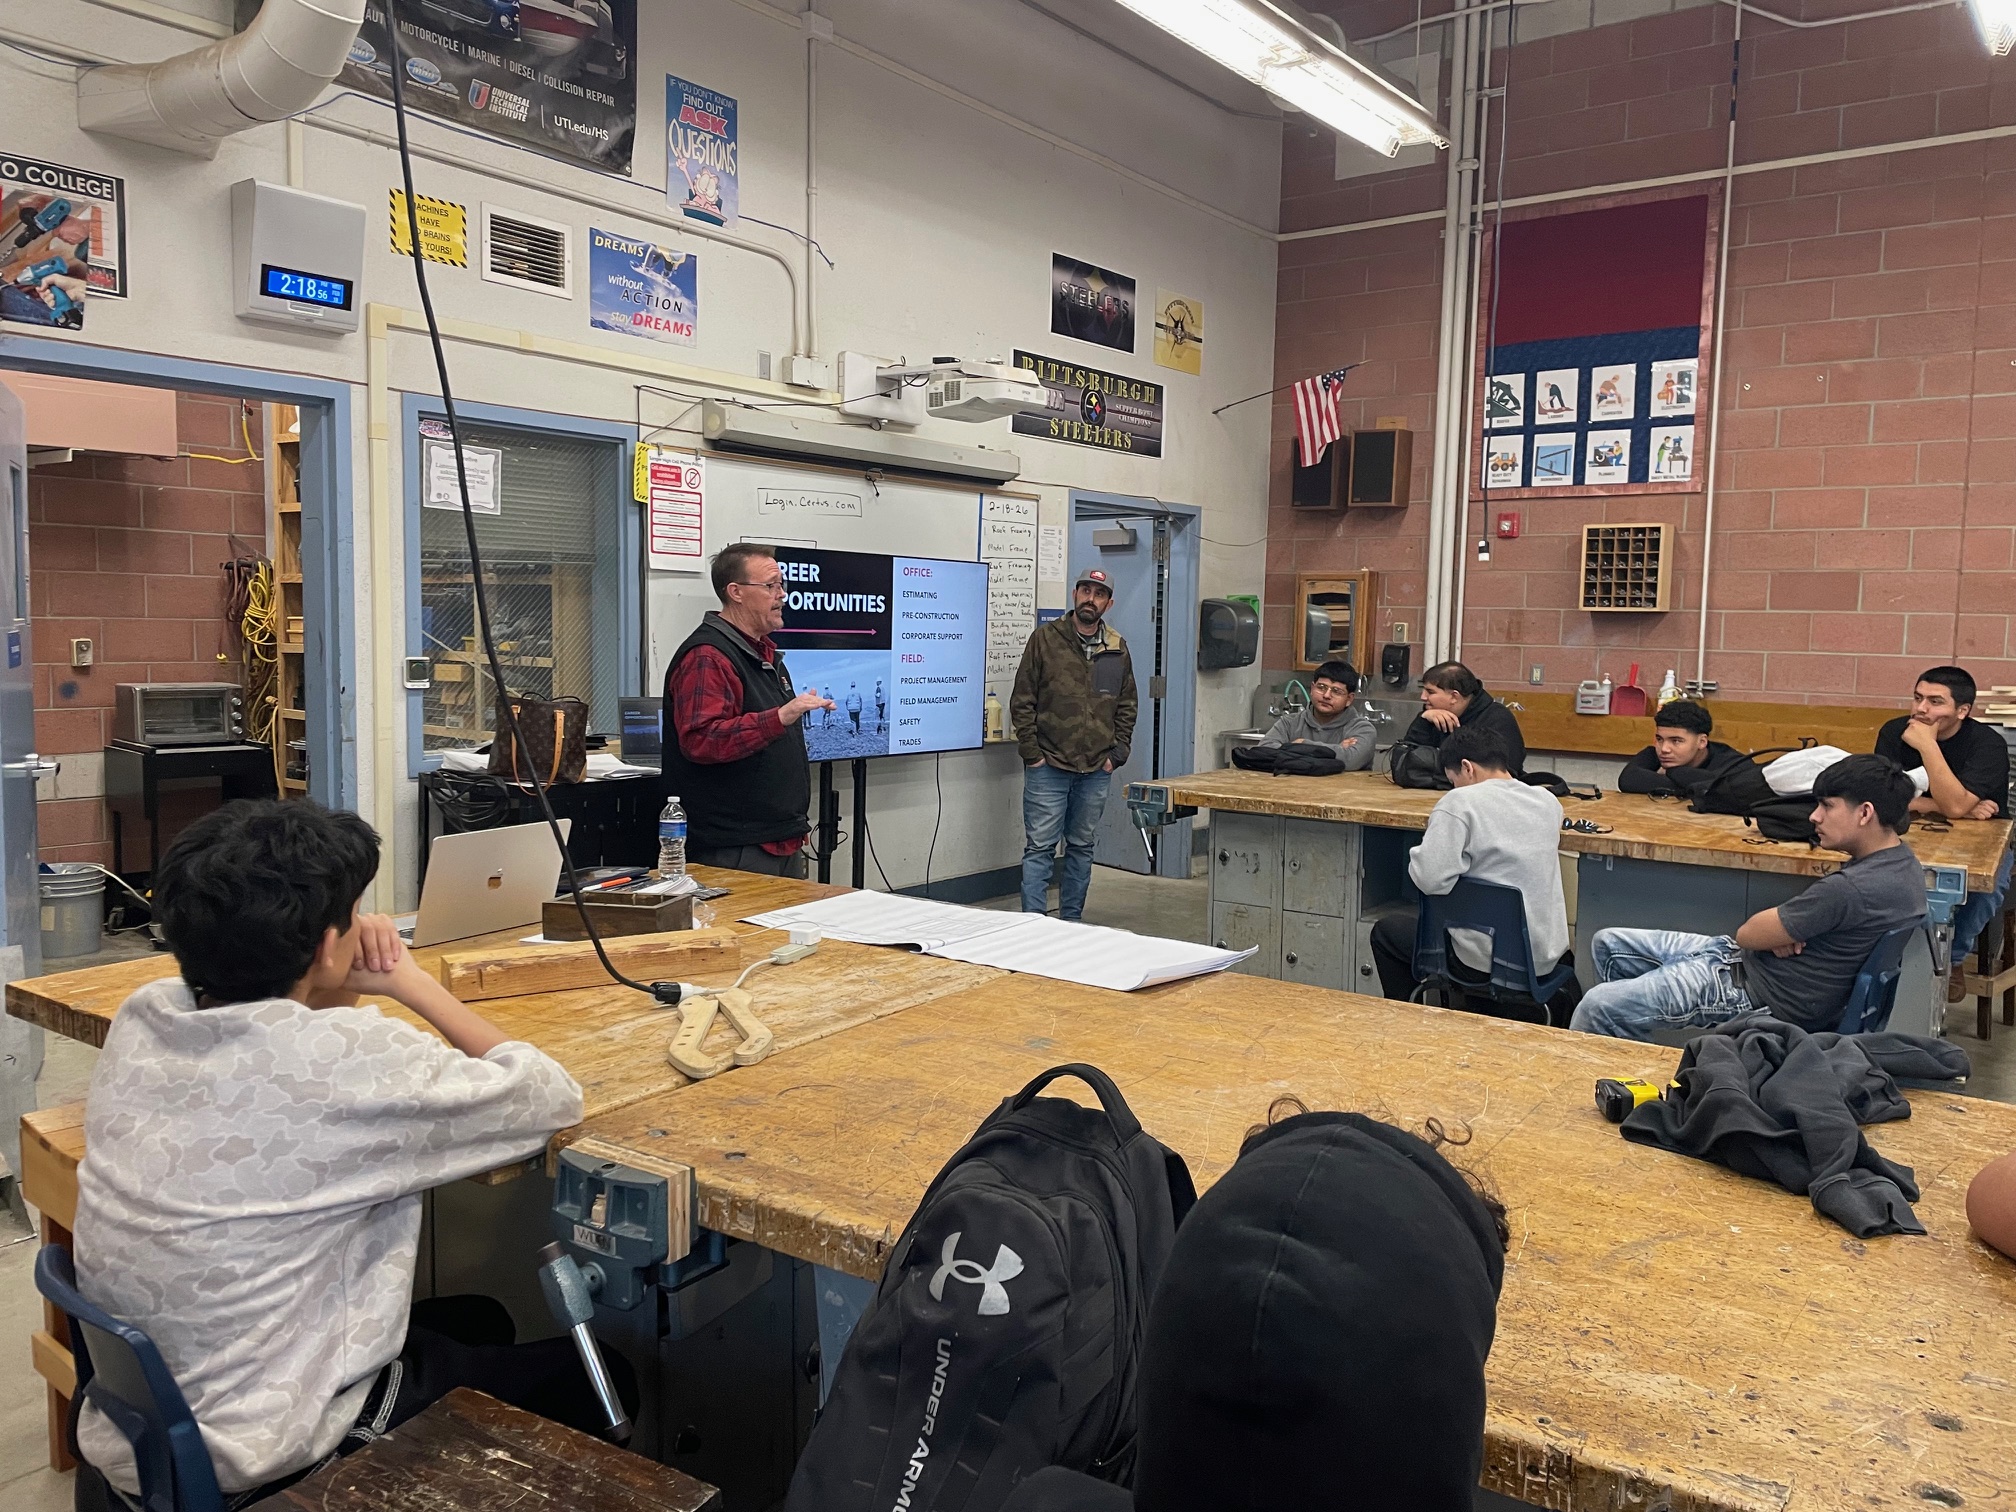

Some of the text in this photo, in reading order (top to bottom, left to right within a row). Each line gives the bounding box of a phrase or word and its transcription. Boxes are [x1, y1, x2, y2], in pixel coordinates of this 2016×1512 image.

[365, 8, 615, 108] AUT MOTORCYCLE MARINE DIESEL COLLISION REPAIR
[491, 87, 530, 108] UNIVERSAL
[669, 78, 677, 87] IF
[677, 81, 692, 93] YOU
[693, 86, 713, 101] DON'T
[488, 103, 527, 122] INSTITUTE
[490, 95, 529, 115] TECHNICAL
[683, 92, 724, 117] FIND OUT.
[553, 115, 609, 141] UTI.edu/HS
[679, 104, 728, 139] ASK
[668, 118, 736, 176] QUESTIONS
[0, 160, 19, 178] O
[25, 166, 113, 198] COLLEGE
[414, 202, 449, 217] ACHINES
[420, 215, 440, 228] HAVE
[423, 229, 451, 242] BRAINS
[425, 241, 452, 255] YOURS!
[595, 235, 644, 257] DREAMS
[281, 274, 328, 300] 2:18 56
[608, 274, 643, 291] without
[621, 289, 682, 313] ACTION
[610, 311, 632, 325] stay
[632, 312, 692, 337] DREAMS
[1021, 355, 1156, 405] PITTSBURGH
[1050, 417, 1133, 449] STEELERS
[989, 501, 1028, 515] 2-18-26
[992, 525, 1006, 534] Roof
[1009, 544, 1028, 554] Frame
[778, 561, 820, 583] REER
[903, 566, 933, 578] OFFICE:
[1007, 574, 1029, 584] Frame
[902, 590, 938, 600] ESTIMATING
[901, 611, 960, 620] PRE-CONSTRUCTION
[901, 632, 937, 640] CORPORATE
[901, 653, 925, 663] FIELD:
[987, 664, 1003, 675] Model
[927, 676, 968, 684] MANAGEMENT
[900, 696, 958, 706] FIELD MANAGEMENT
[899, 717, 921, 726] SAFETY
[898, 738, 922, 747] TRADES
[921, 1338, 951, 1436] UNDER
